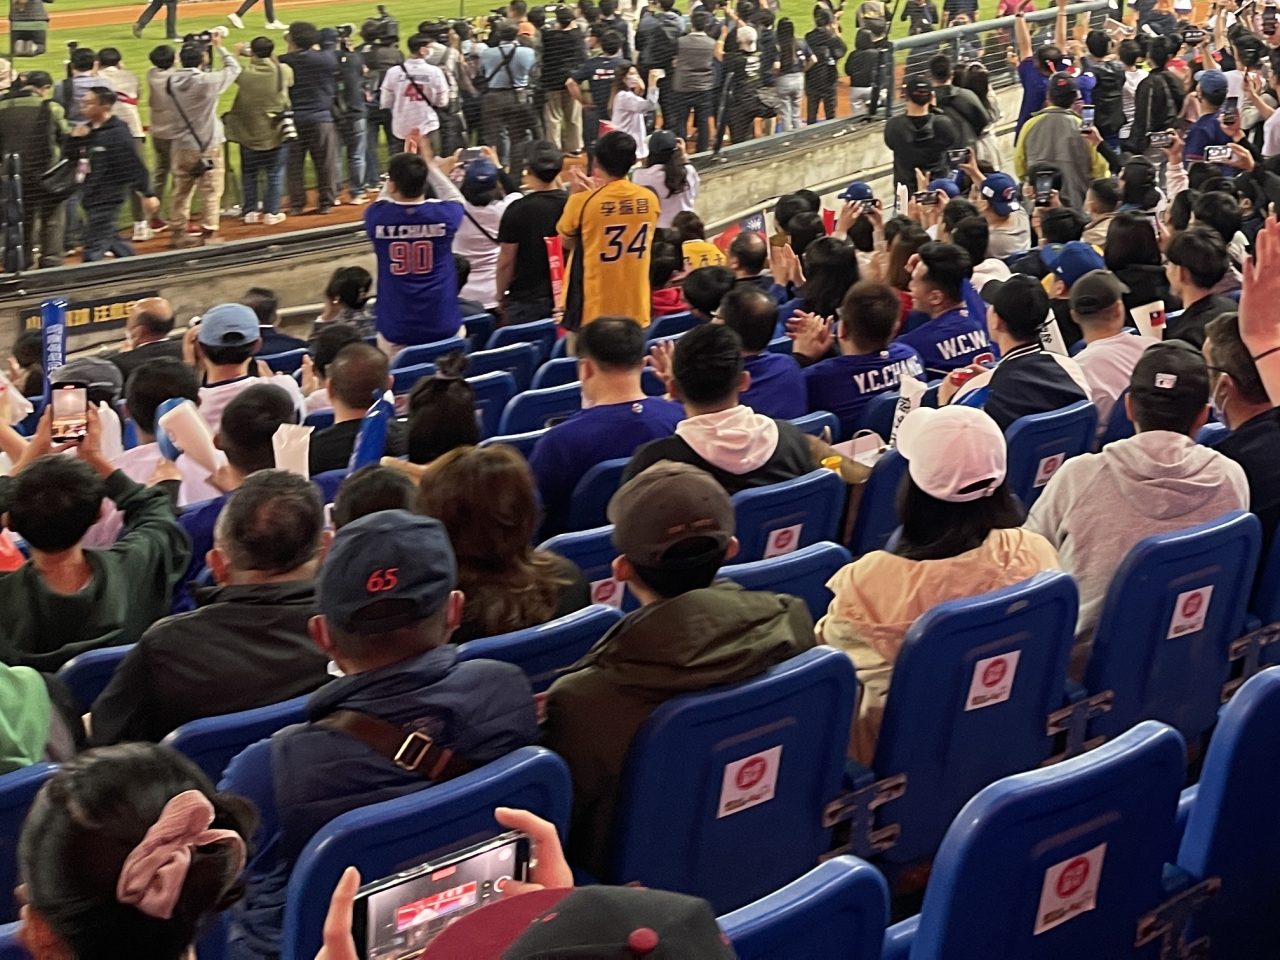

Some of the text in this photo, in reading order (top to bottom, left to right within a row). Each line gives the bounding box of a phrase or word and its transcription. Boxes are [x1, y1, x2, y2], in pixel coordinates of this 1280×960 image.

[389, 240, 434, 275] 90
[600, 223, 650, 262] 34
[367, 567, 400, 592] 65
